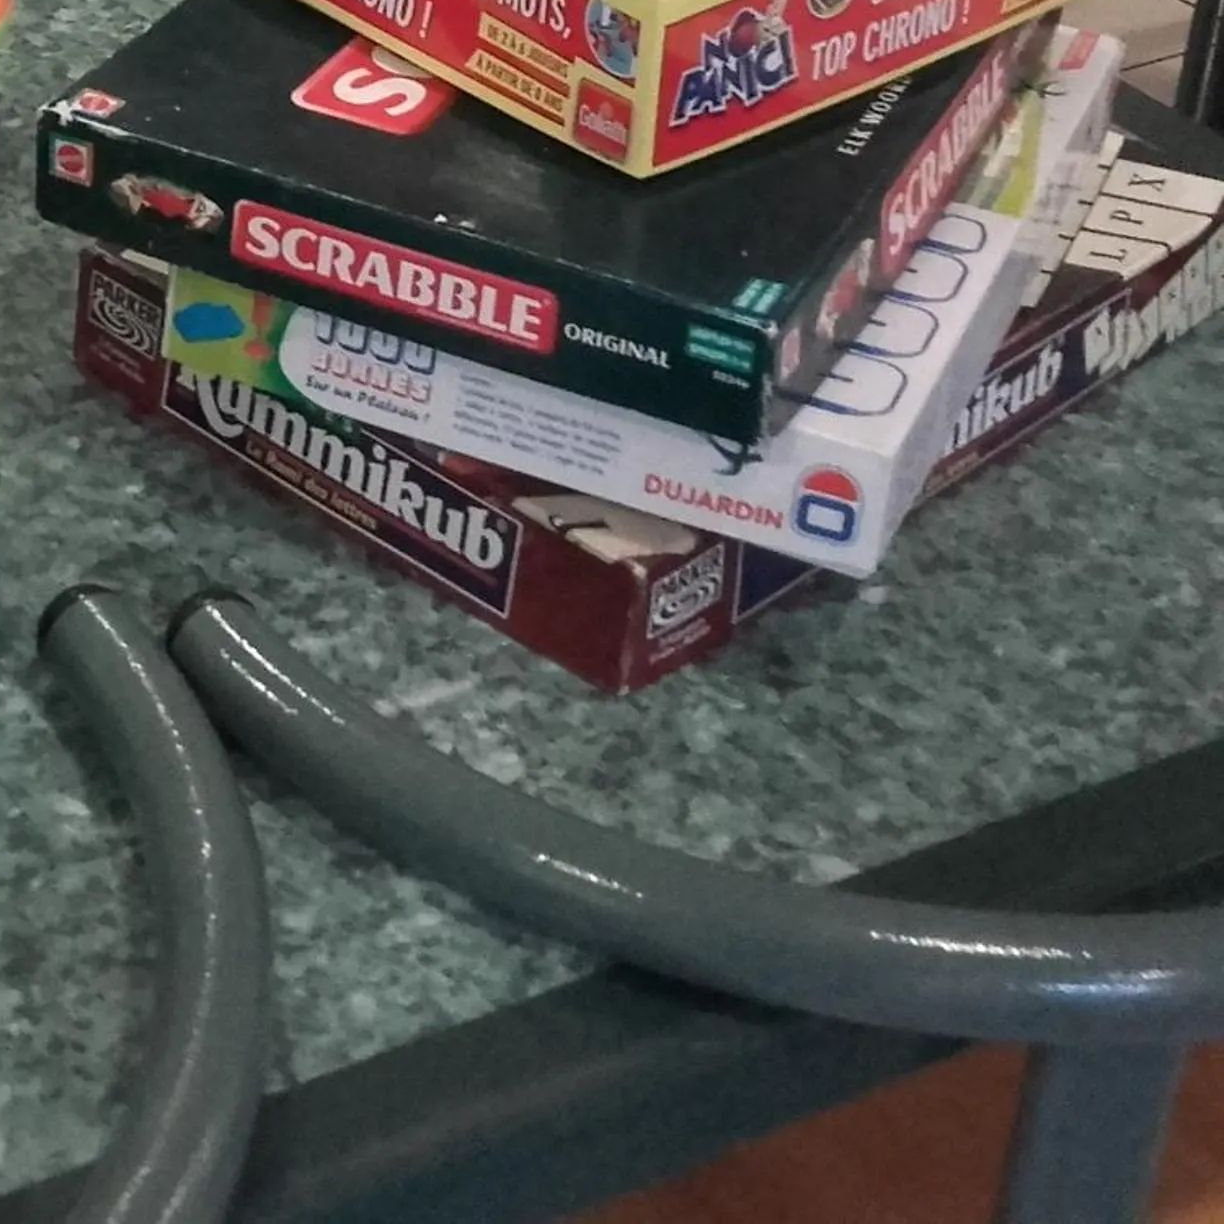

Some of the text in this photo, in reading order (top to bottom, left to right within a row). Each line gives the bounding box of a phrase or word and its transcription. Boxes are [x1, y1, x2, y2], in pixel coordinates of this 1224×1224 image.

[419, 0, 434, 39] !
[810, 30, 856, 81] TOP
[332, 48, 432, 117] S
[837, 127, 874, 157] ELK
[1128, 173, 1166, 192] X
[245, 215, 543, 342] SCRABBLE
[563, 322, 672, 371] ORIGINAL
[643, 472, 785, 529] DUJARDIN
